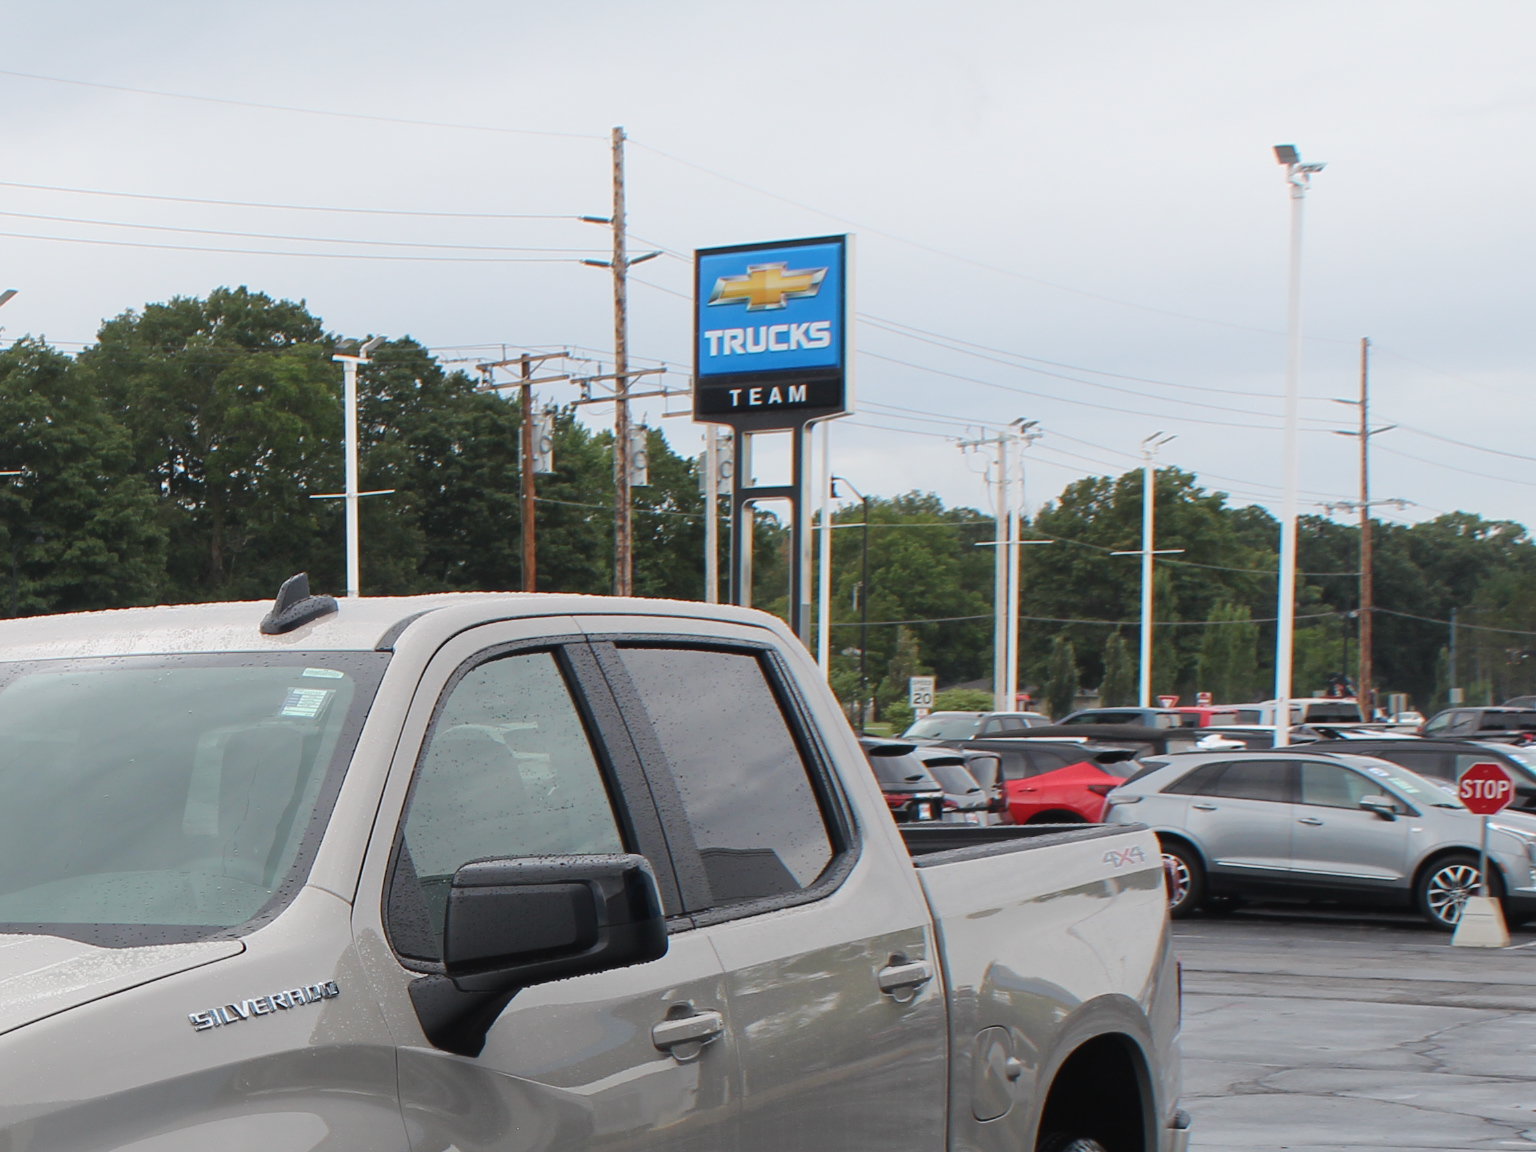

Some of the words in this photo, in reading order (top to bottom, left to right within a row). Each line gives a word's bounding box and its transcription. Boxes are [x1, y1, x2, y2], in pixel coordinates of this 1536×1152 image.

[704, 320, 831, 356] TRUCKS
[729, 383, 808, 407] TEAM
[913, 692, 931, 705] 20
[1461, 779, 1510, 799] STOP
[188, 979, 340, 1032] SILVERADO
